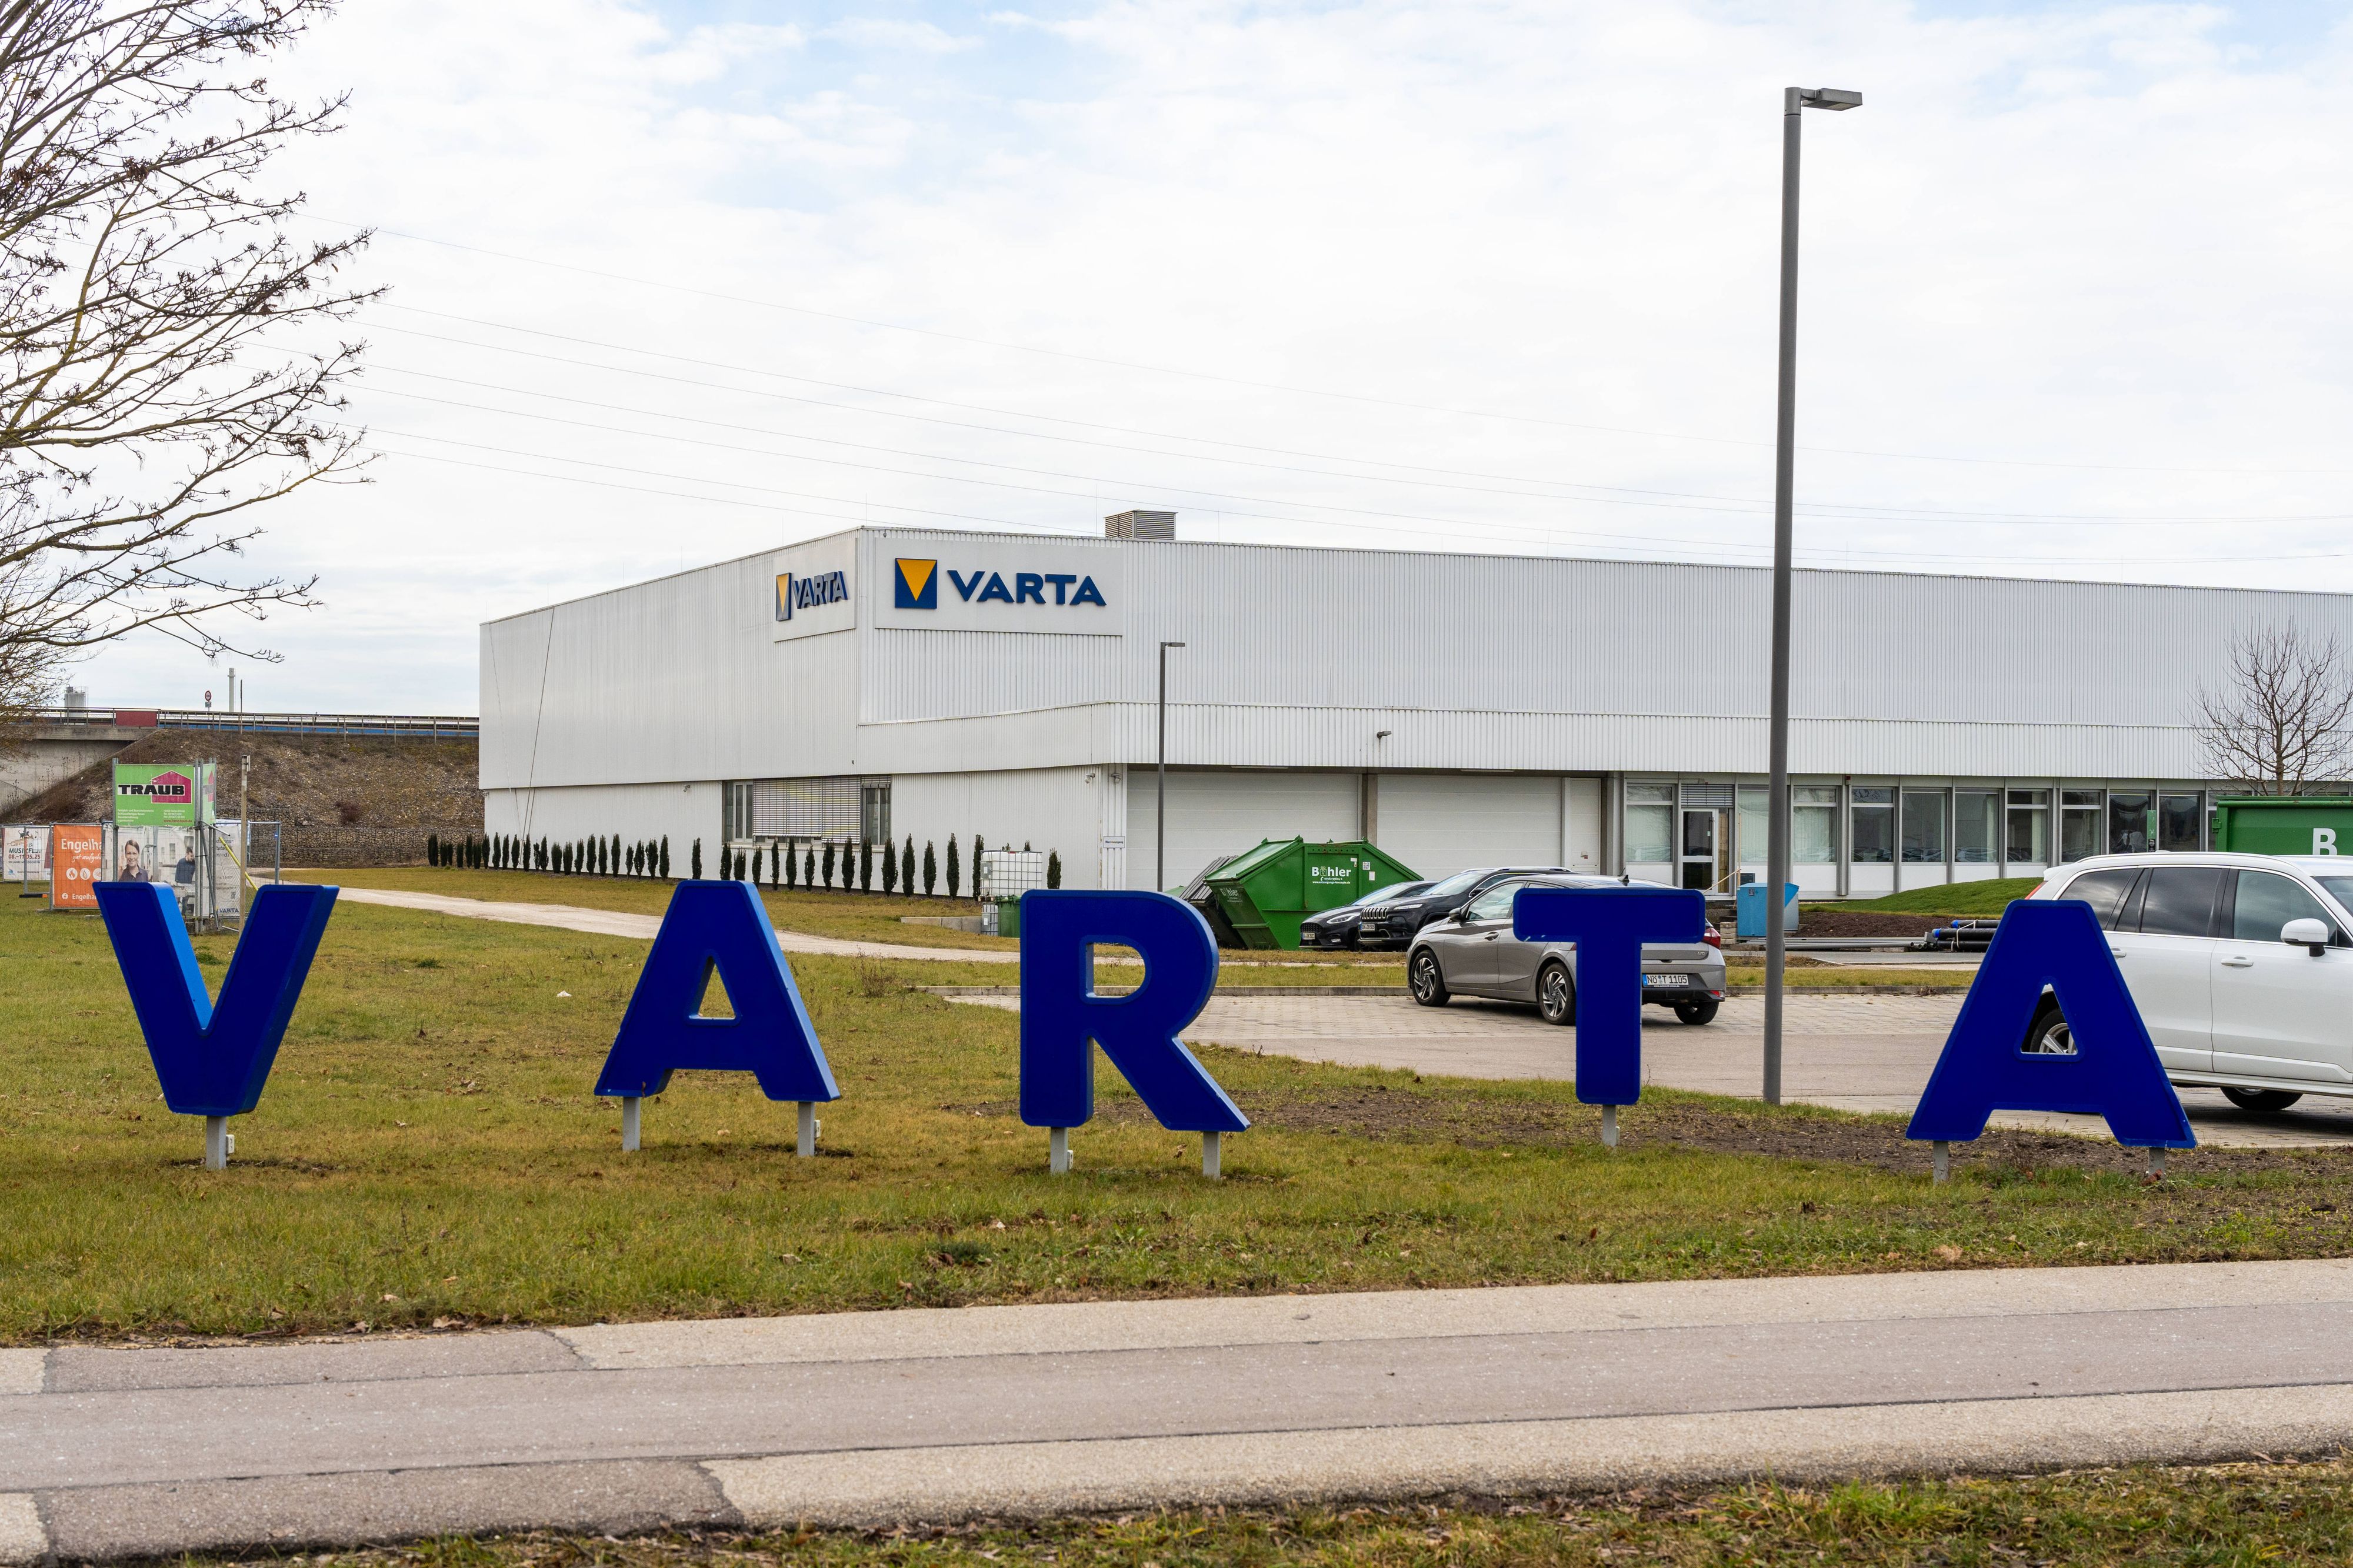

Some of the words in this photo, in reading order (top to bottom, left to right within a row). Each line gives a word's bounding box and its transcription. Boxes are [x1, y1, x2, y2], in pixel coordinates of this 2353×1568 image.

[792, 571, 848, 609] VARTA
[946, 569, 1107, 606] VARTA
[118, 785, 185, 795] TRAUB
[2312, 828, 2338, 855] B
[1647, 975, 1657, 984] NÖ
[1662, 975, 1667, 984] T
[1669, 975, 1687, 984] 1105
[92, 879, 2197, 1149] VARTA
